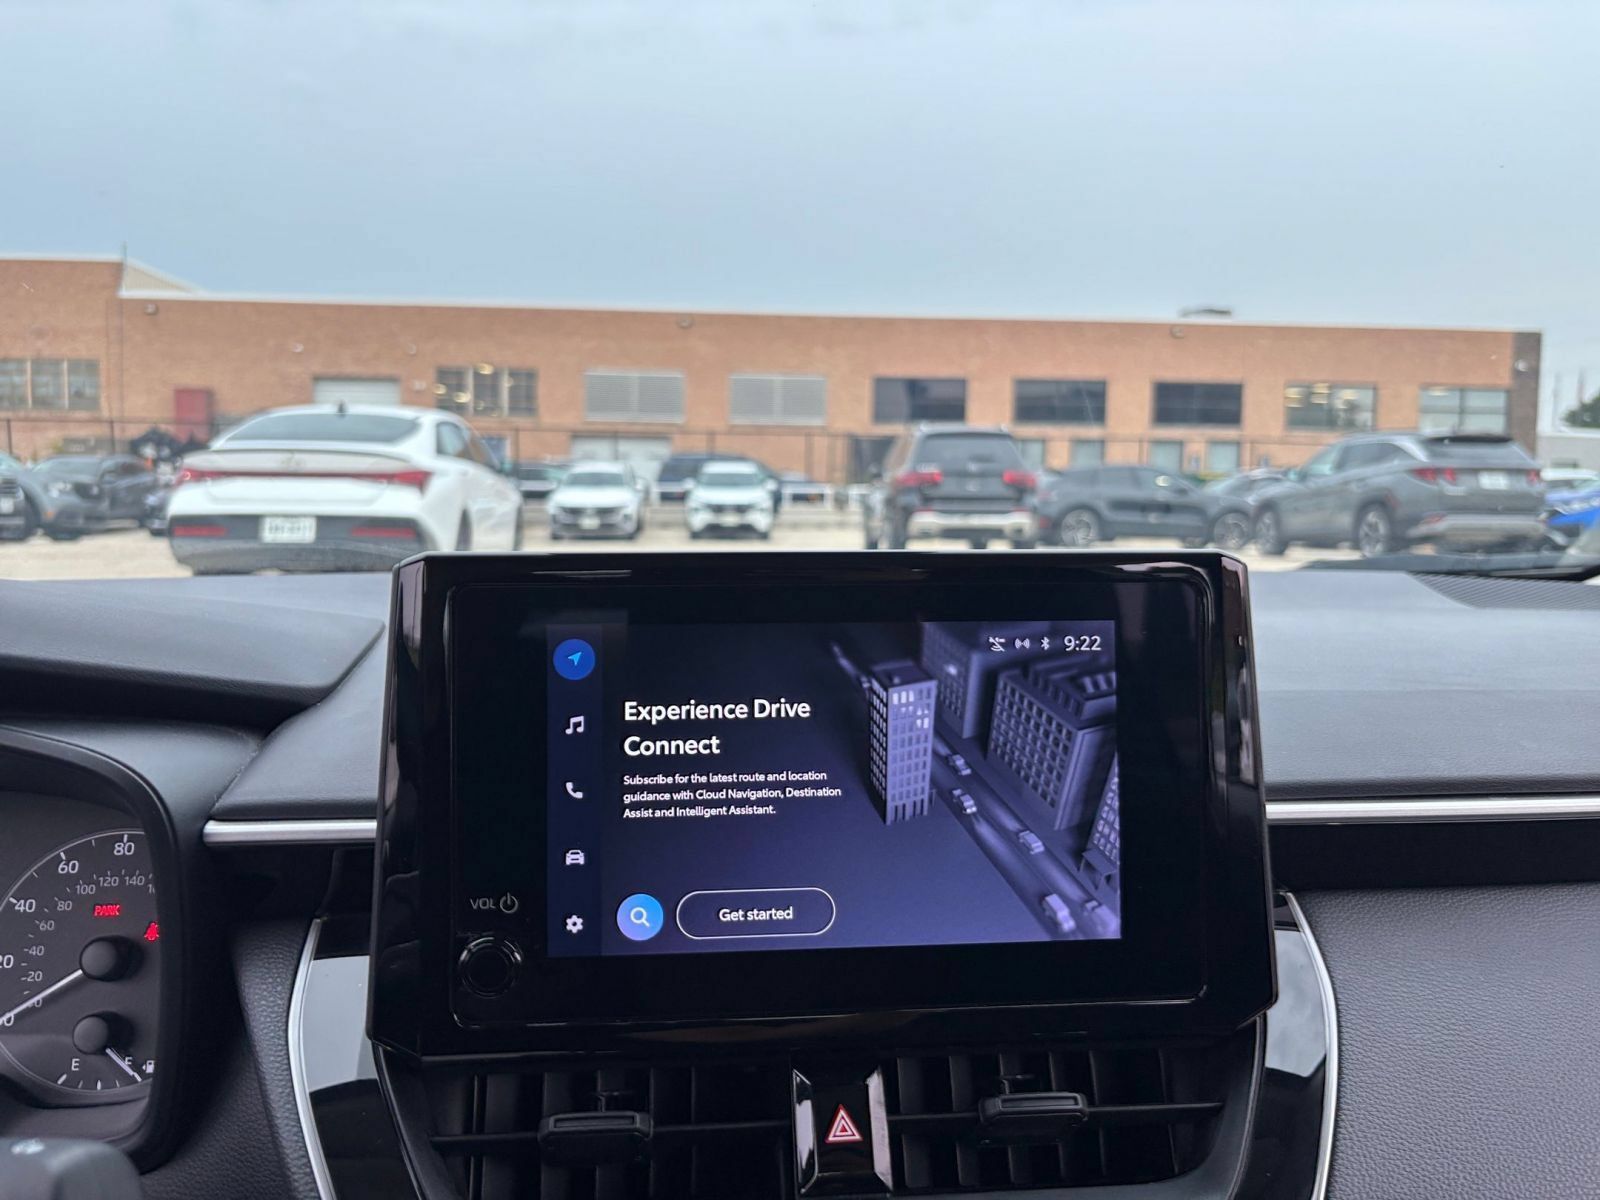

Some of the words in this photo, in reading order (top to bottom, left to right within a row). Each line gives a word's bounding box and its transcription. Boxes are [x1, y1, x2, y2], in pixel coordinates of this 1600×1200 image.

[1064, 636, 1101, 651] 9:22
[624, 700, 747, 725] Experience
[754, 698, 811, 718] Drive
[624, 735, 720, 756] Connect
[623, 774, 673, 785] Subscribe
[675, 774, 688, 783] for
[690, 773, 707, 783] the
[709, 773, 737, 783] latest
[739, 772, 764, 782] route
[767, 772, 786, 781] and
[788, 771, 826, 780] location
[623, 790, 670, 803] guidance
[672, 789, 693, 800] with
[696, 789, 726, 799] Cloud
[728, 788, 784, 801] Navigation,
[786, 787, 841, 798] Destination
[623, 808, 653, 818] Assist
[655, 807, 674, 817] and
[677, 806, 726, 818] Intelligent
[729, 805, 775, 815] Assistant.
[113, 842, 135, 856] 80
[58, 860, 79, 874] 60
[99, 876, 119, 887] 120
[124, 876, 145, 886] 140
[75, 884, 96, 895] 100
[15, 899, 36, 912] 40
[57, 900, 73, 911] 80
[470, 897, 496, 910] VOL
[94, 905, 121, 916] PARK
[719, 908, 744, 921] Get
[747, 907, 793, 920] started
[39, 920, 55, 931] 60
[71, 1058, 80, 1071] E
